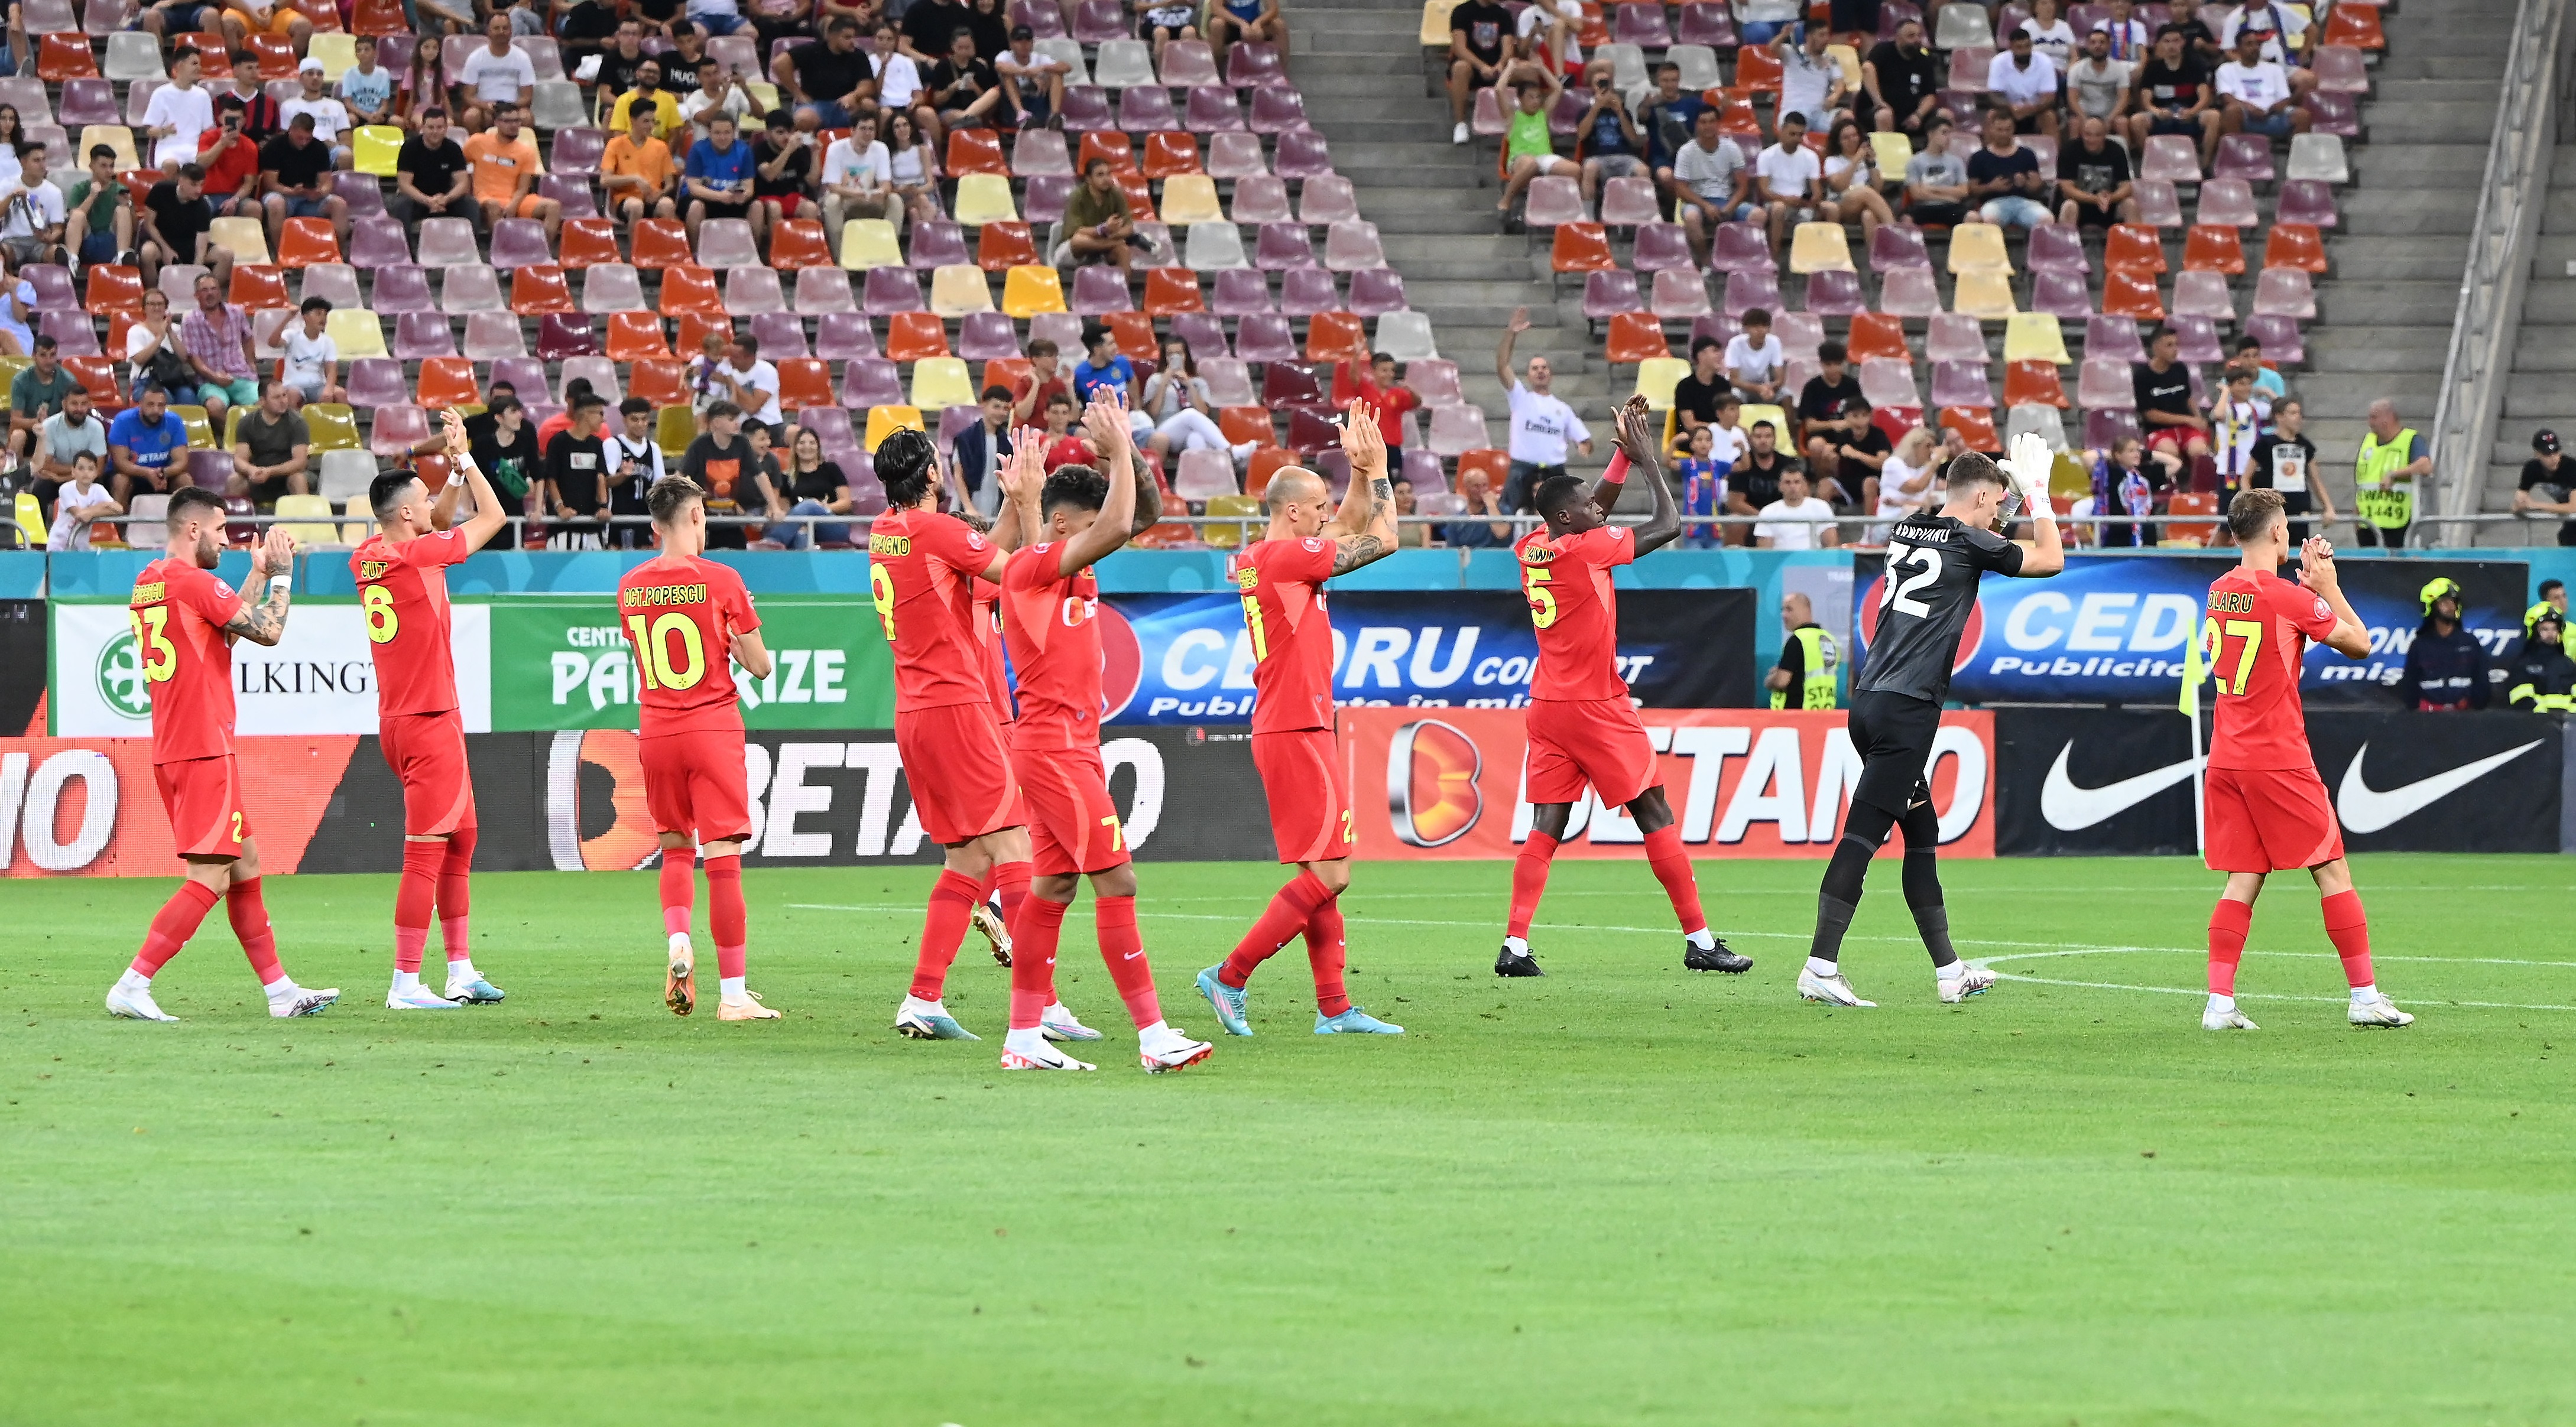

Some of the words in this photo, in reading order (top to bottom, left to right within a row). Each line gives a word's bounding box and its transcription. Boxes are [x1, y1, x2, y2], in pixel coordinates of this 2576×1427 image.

[623, 583, 707, 607] OCT.POPESCU
[870, 562, 897, 642] 9
[1526, 565, 1558, 630] 5
[1879, 540, 1943, 620] 32
[627, 611, 706, 691] 10
[232, 811, 242, 844] 2
[1101, 814, 1121, 852] 7
[1341, 809, 1352, 844] 2
